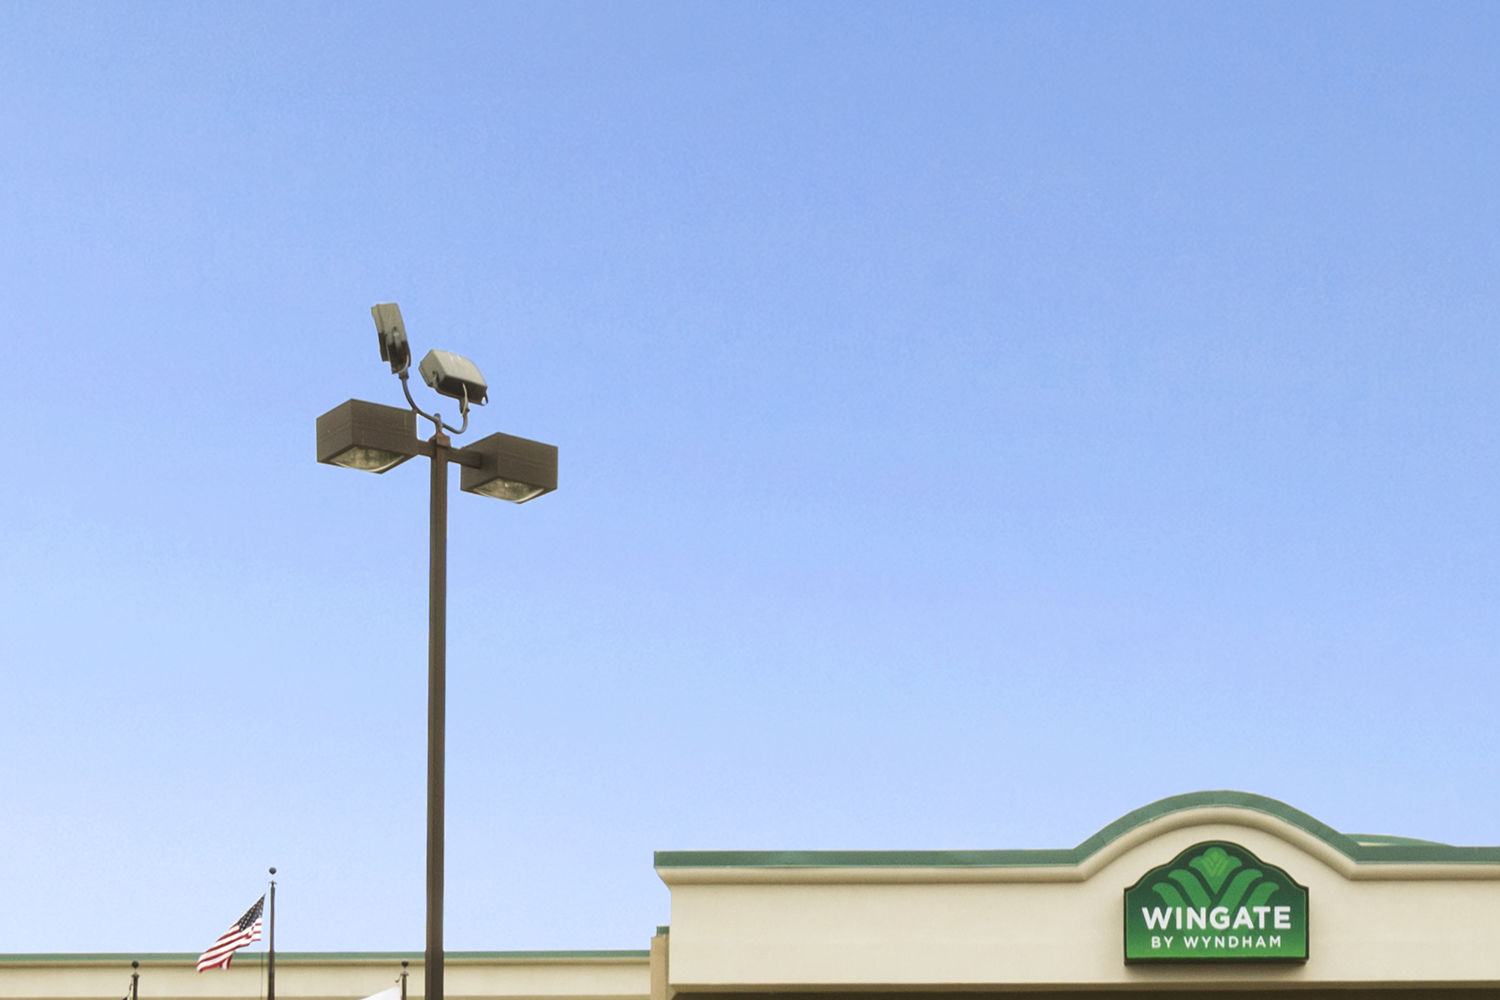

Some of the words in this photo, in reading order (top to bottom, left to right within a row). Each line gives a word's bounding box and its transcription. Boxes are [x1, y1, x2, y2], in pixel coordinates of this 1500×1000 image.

[1141, 906, 1292, 930] WINGATE
[1151, 936, 1174, 949] BY
[1184, 935, 1282, 949] WYNDHAM
